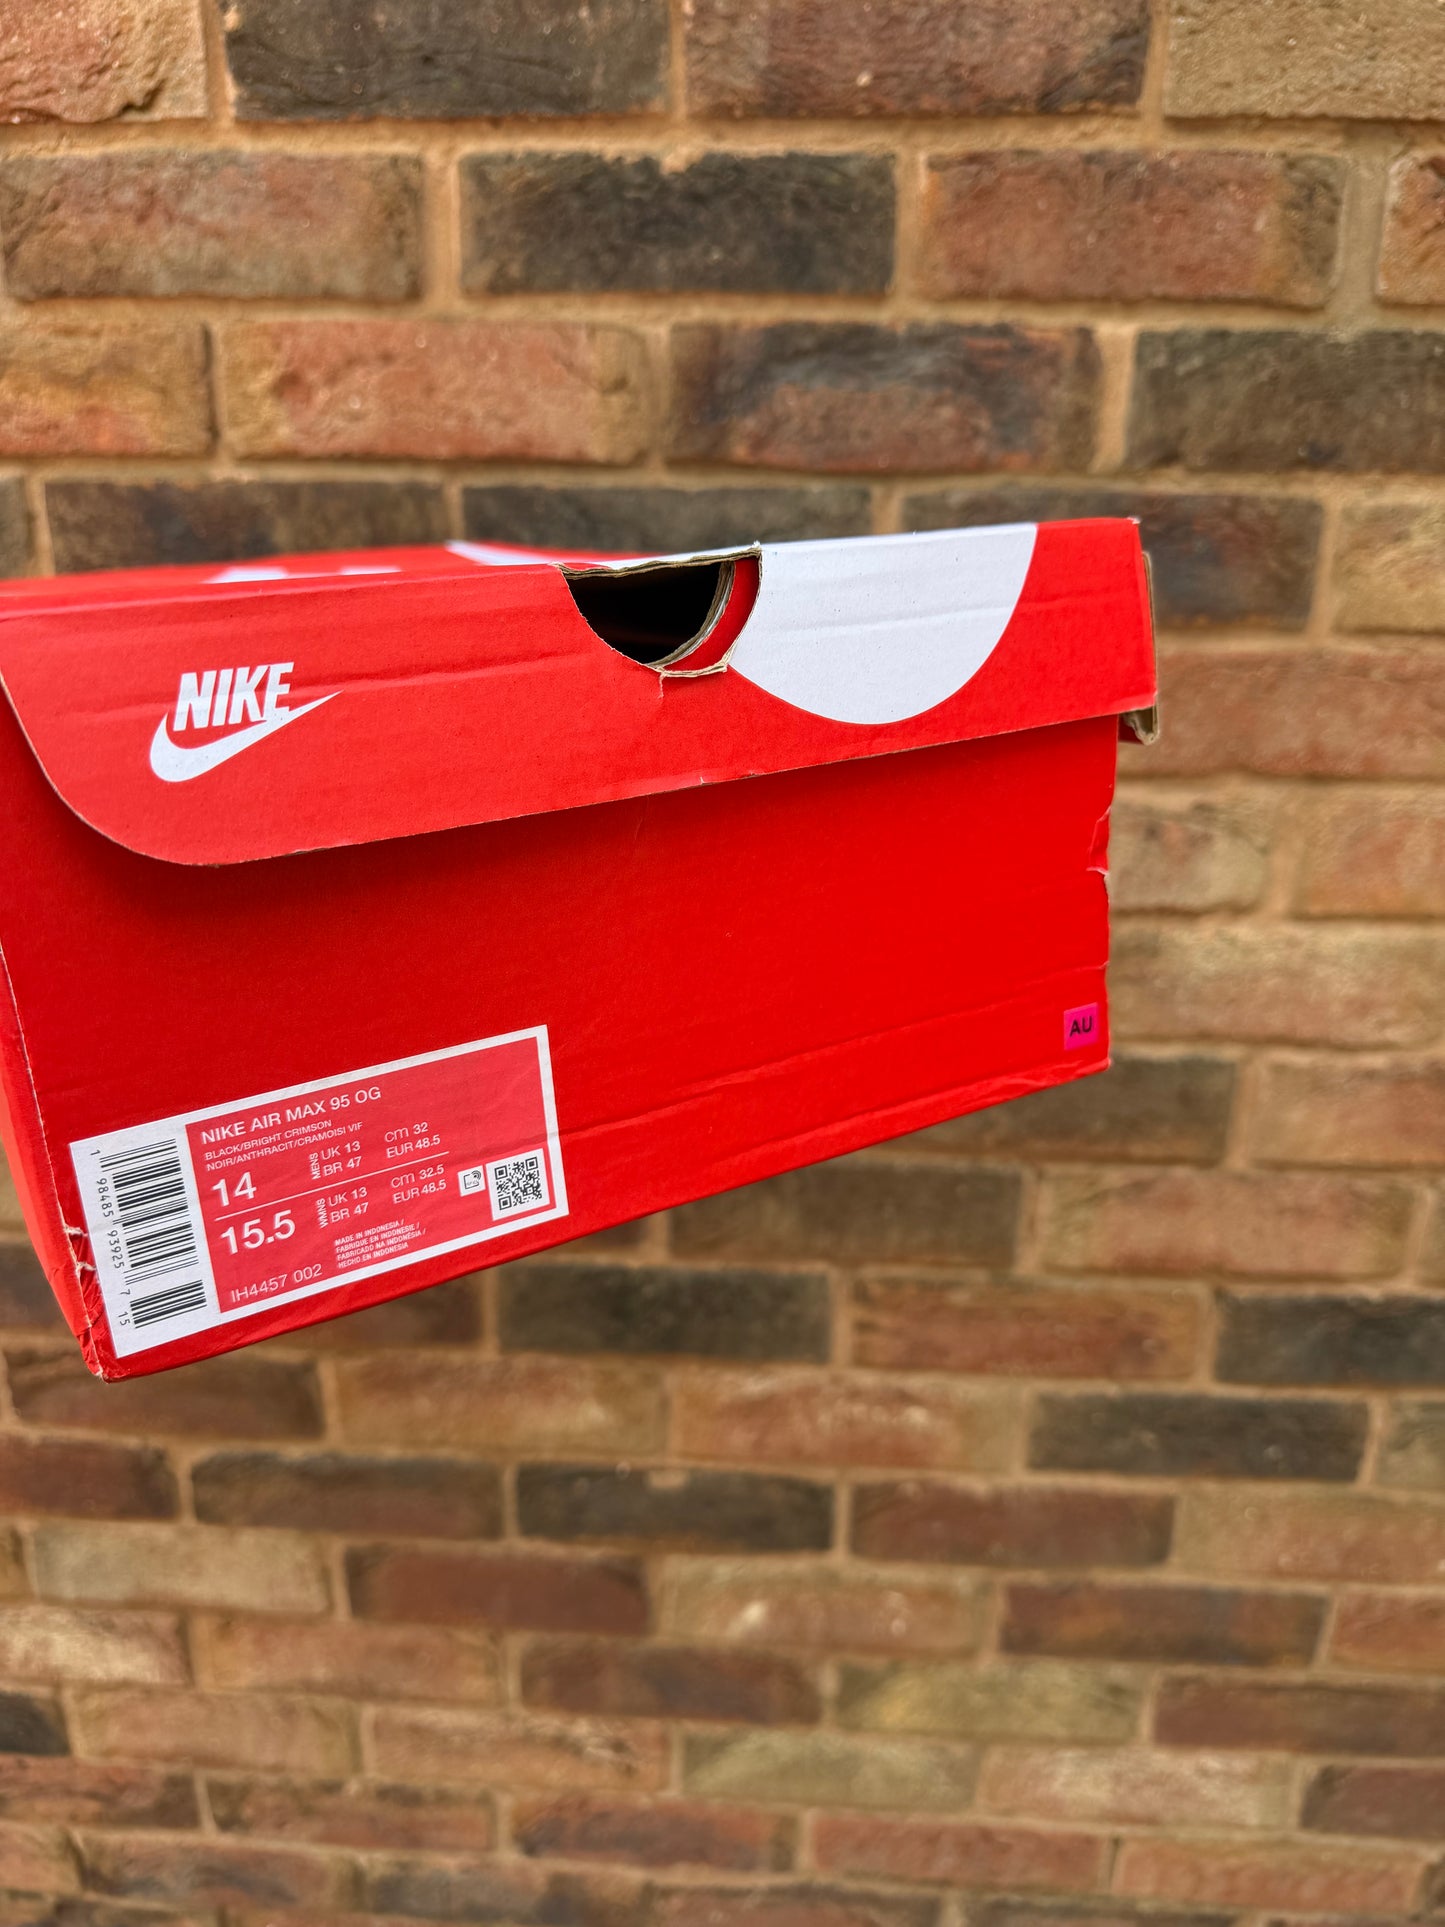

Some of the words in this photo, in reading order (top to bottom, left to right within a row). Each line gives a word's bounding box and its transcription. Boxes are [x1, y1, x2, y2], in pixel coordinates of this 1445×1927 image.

[173, 662, 294, 731] NIKE
[1069, 1015, 1093, 1037] AU
[201, 1121, 246, 1145] NIKE
[250, 1112, 281, 1132] AIR
[286, 1101, 326, 1123] MAX
[330, 1094, 350, 1111] 95
[355, 1086, 382, 1104] OG
[204, 1132, 282, 1161] BLACK/BRIGHT
[285, 1120, 332, 1139] CRIMSON
[384, 1127, 409, 1143] cm
[413, 1121, 429, 1135] 32
[206, 1127, 346, 1172] NOIR/ANTHRACIT/CRAMOISI
[348, 1122, 363, 1133] VIF
[321, 1145, 341, 1160] UK
[344, 1140, 361, 1153] 13
[386, 1141, 414, 1159] EUR
[415, 1134, 441, 1150] 48.5
[308, 1152, 321, 1180] MENS
[323, 1161, 343, 1177] BR
[346, 1155, 362, 1169] 47
[390, 1172, 416, 1189] cm
[419, 1164, 445, 1180] 32.5
[96, 1177, 114, 1218] 98485
[211, 1171, 257, 1207] 14
[328, 1191, 348, 1207] UK
[351, 1186, 368, 1200] 13
[392, 1187, 420, 1204] EUR
[421, 1179, 447, 1195] 48.5
[316, 1198, 329, 1229] WMNS
[330, 1208, 351, 1224] BR
[353, 1201, 369, 1215] 47
[220, 1209, 296, 1256] 15.5
[334, 1234, 354, 1246] MADE
[355, 1231, 363, 1239] IN
[364, 1220, 400, 1237] INDONESIA
[369, 1236, 379, 1244] EN
[107, 1230, 125, 1270] 93925
[337, 1244, 374, 1261] FABRICADO
[375, 1241, 386, 1250] NA
[337, 1257, 361, 1269] HECHO
[362, 1253, 372, 1261] EN
[373, 1241, 409, 1259] INDONESIA
[120, 1288, 131, 1297] 7
[231, 1274, 288, 1303] IH4457
[293, 1263, 322, 1283] 002
[118, 1311, 131, 1326] 15
